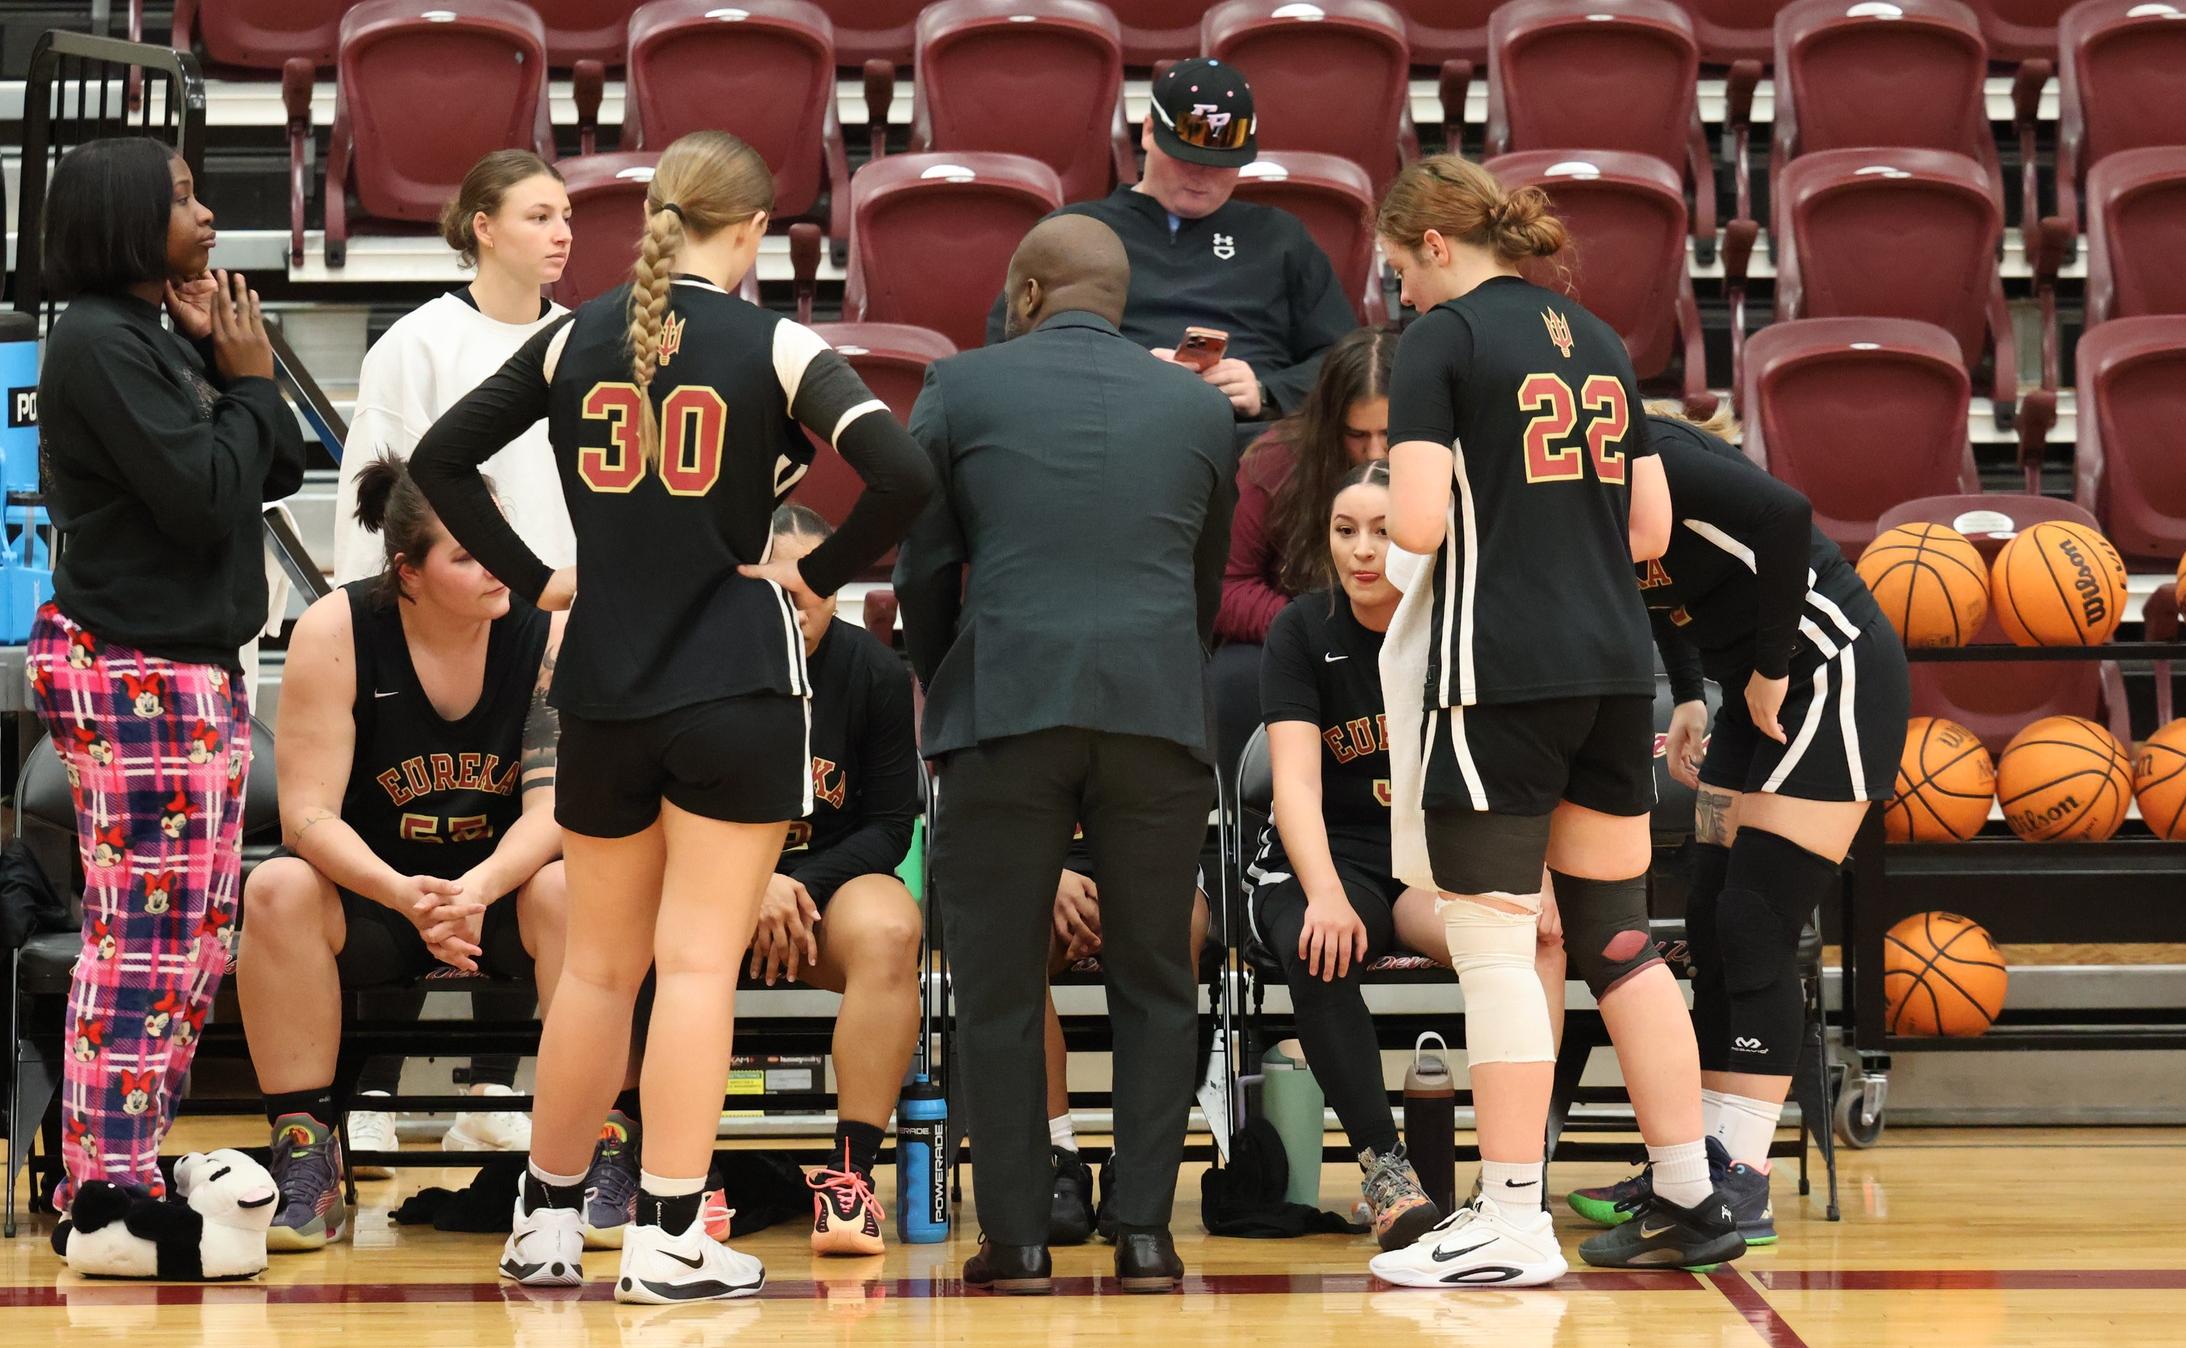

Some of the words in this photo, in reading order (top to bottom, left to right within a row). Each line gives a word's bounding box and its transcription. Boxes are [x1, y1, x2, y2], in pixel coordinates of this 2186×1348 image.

[578, 381, 728, 497] 30
[1517, 373, 1629, 485] 22
[2059, 539, 2106, 627] Wilson
[376, 752, 521, 807] EUREKA
